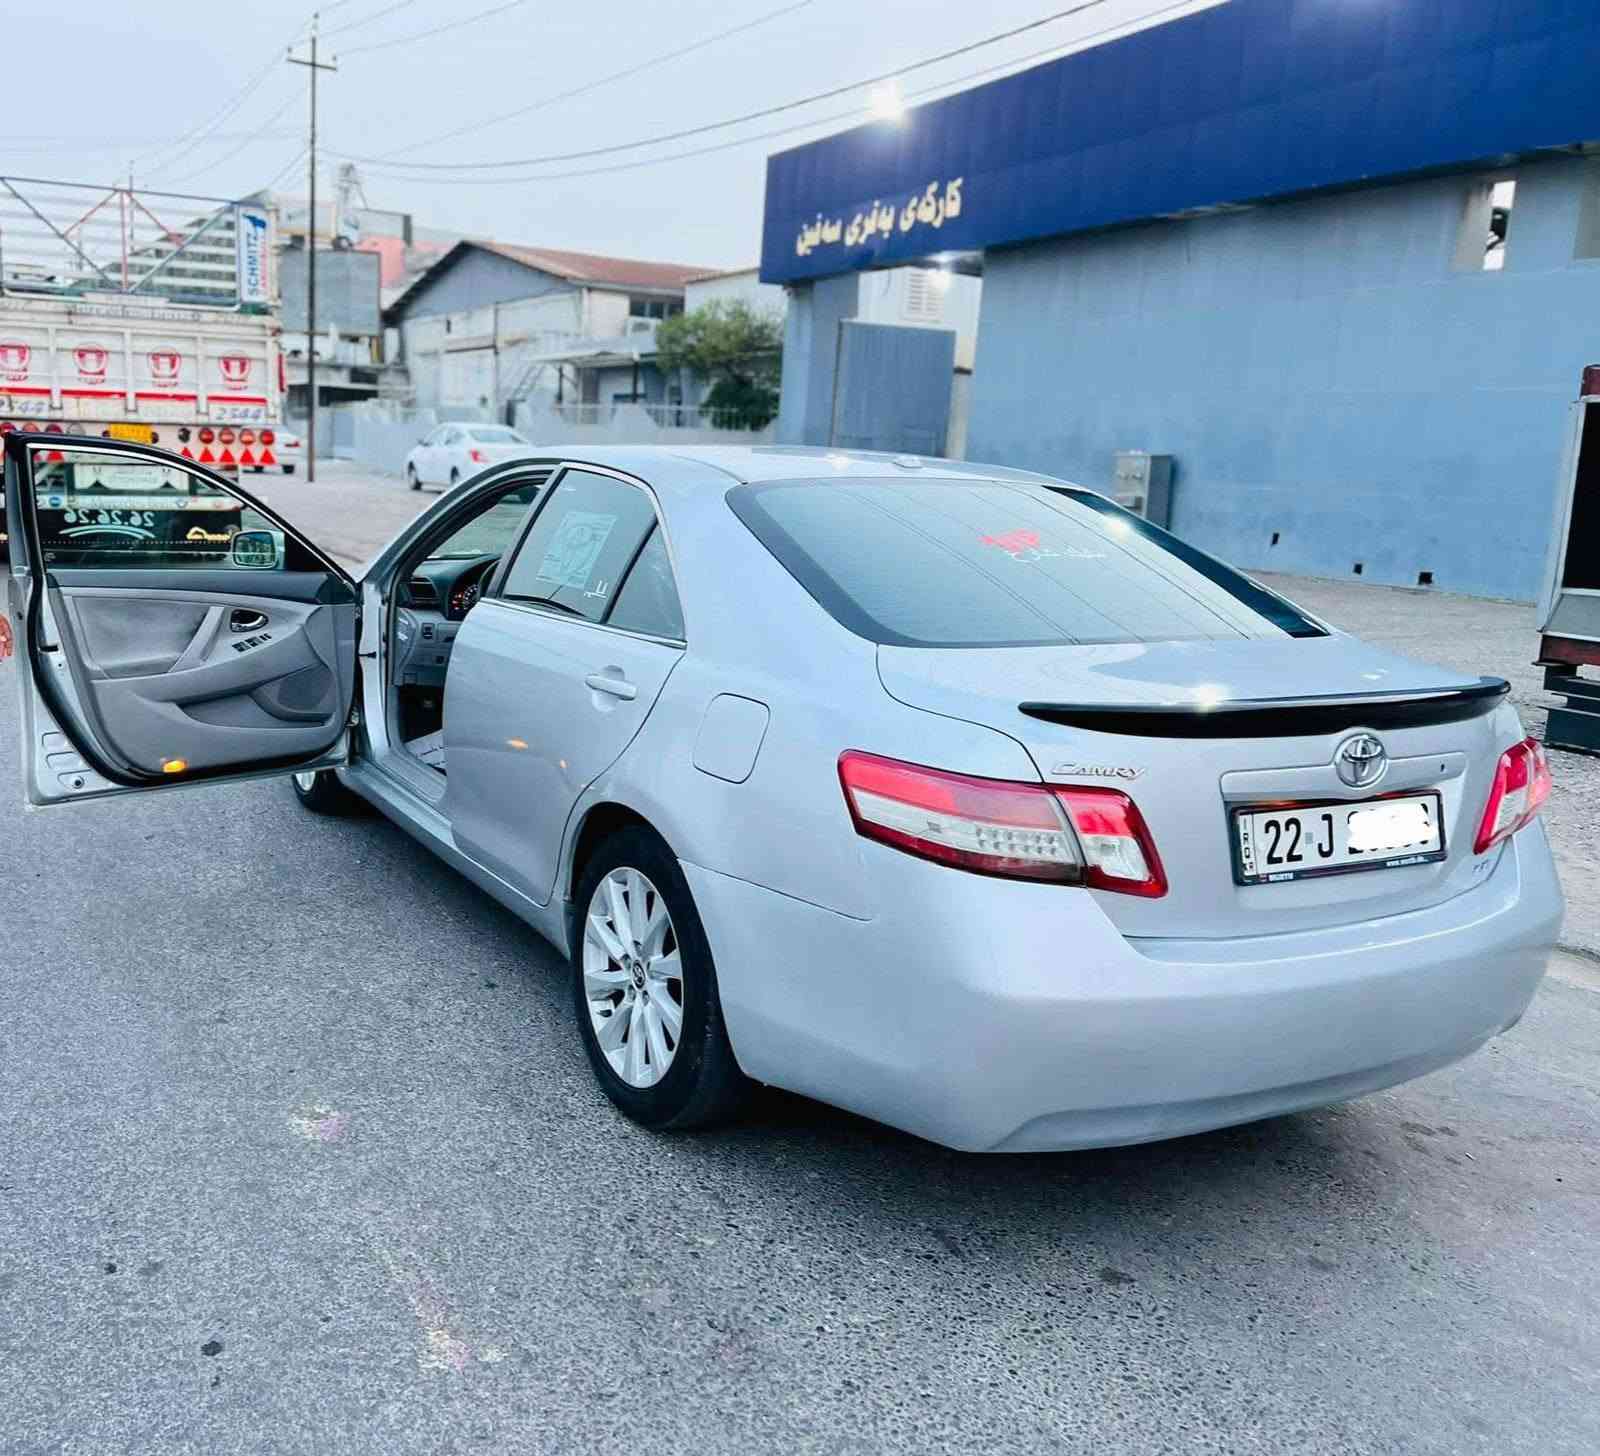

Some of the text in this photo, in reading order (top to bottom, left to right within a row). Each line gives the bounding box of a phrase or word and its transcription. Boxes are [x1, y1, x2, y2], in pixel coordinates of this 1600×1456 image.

[246, 231, 258, 297] SCHMITZ
[1264, 817, 1303, 865] 22
[1317, 813, 1334, 858] J
